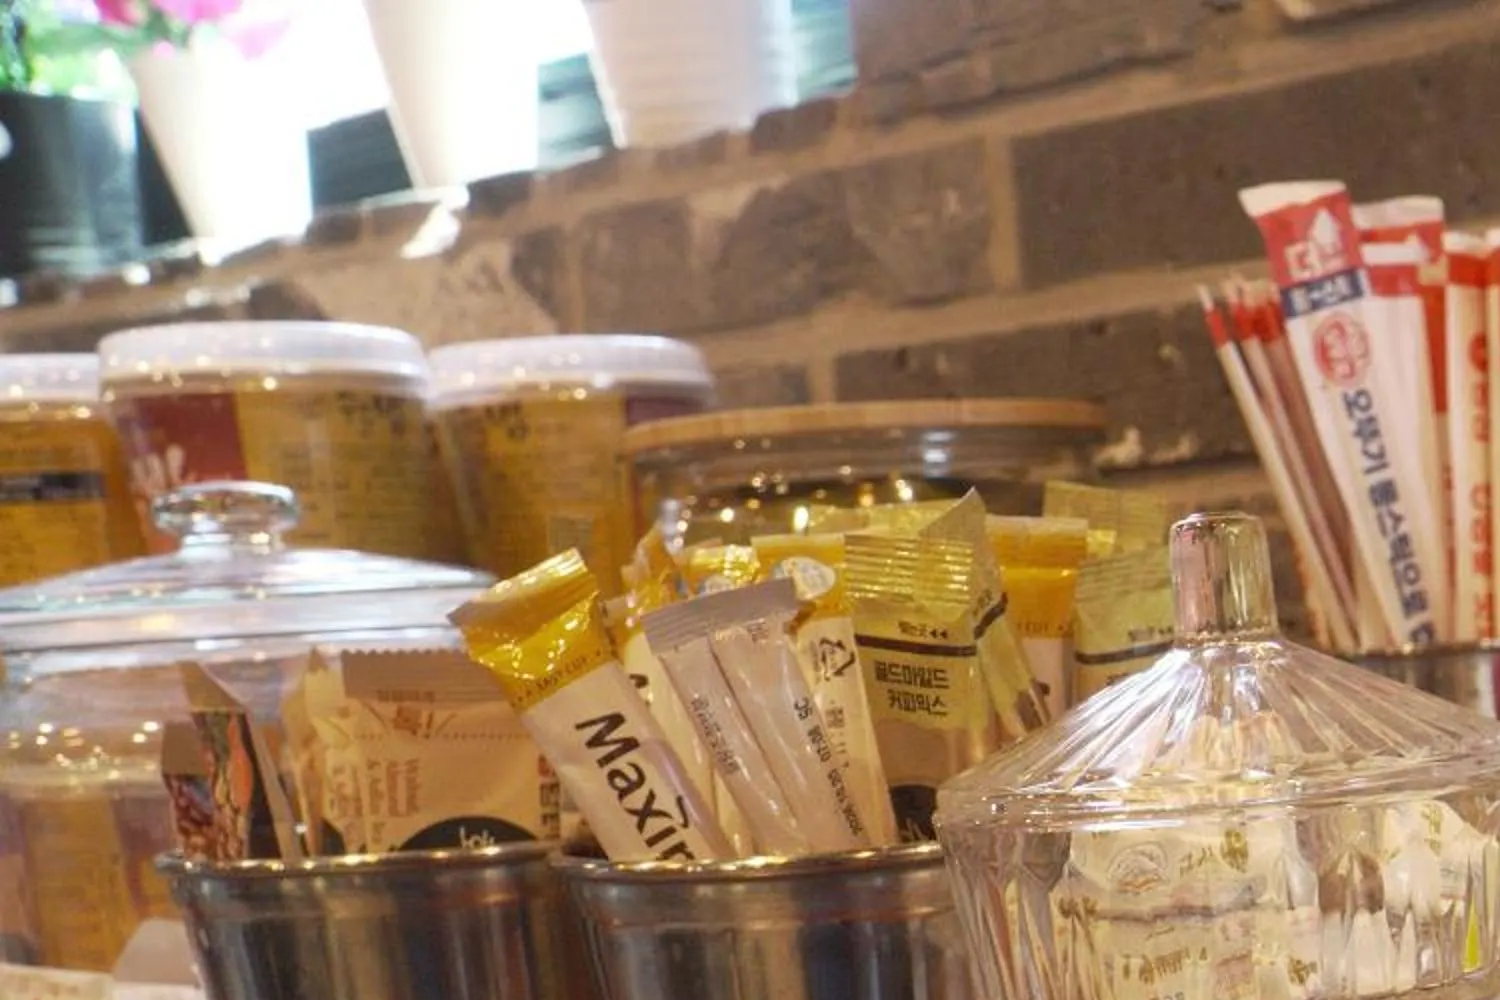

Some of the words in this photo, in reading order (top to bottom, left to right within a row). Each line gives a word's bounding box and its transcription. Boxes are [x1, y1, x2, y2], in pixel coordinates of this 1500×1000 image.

[1342, 388, 1390, 476] 오뚜기
[874, 659, 950, 689] 골드마일드
[887, 688, 949, 716] 커피믹스
